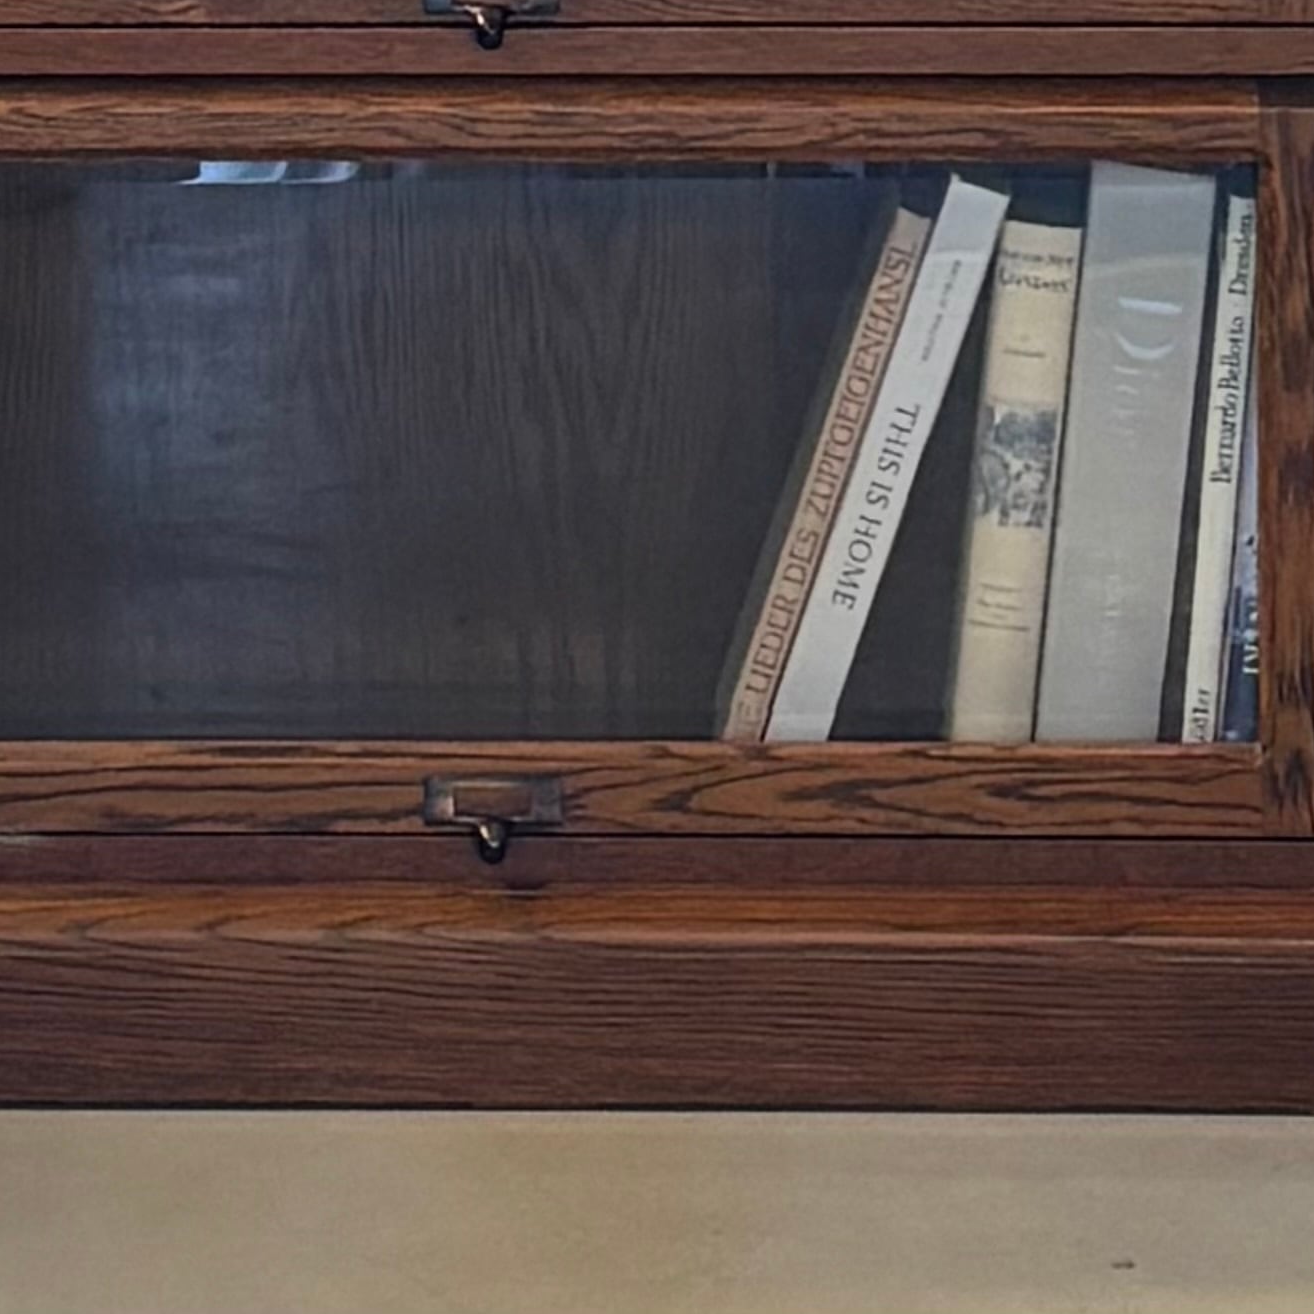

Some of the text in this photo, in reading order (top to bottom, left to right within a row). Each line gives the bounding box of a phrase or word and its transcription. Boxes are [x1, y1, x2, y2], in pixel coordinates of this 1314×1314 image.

[783, 527, 820, 586] DES
[831, 403, 921, 611] THIS IS HOME
